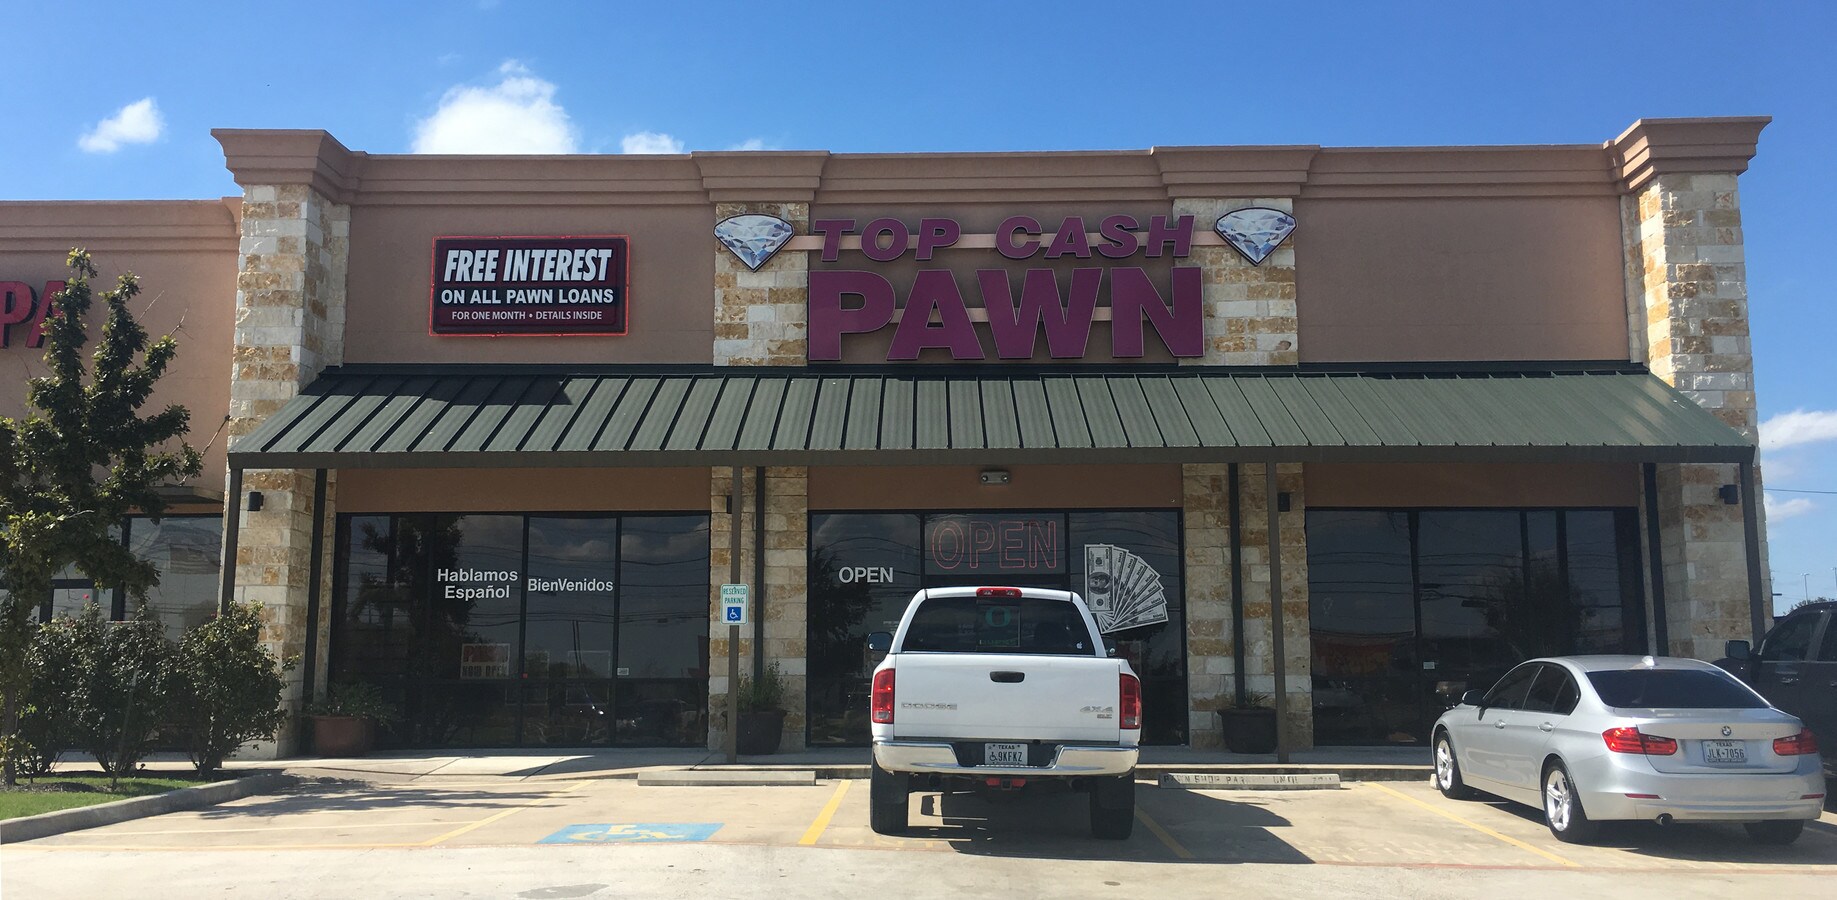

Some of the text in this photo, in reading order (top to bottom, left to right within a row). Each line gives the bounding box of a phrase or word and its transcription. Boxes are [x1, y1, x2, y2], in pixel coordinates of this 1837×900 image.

[813, 215, 1195, 262] TOP CASH
[443, 248, 612, 282] FREE INTEREST
[441, 288, 614, 305] ON ALL PAWN LOANS
[452, 311, 602, 320] FOR ONE MONTH DETAILS INSIDE
[808, 267, 1205, 361] PAWN
[932, 520, 1057, 569] OPEN
[437, 568, 518, 582] Hablamos
[838, 566, 894, 583] OPEN
[444, 585, 510, 601] Español
[527, 578, 614, 592] BienVenidos
[901, 702, 958, 710] DODGE
